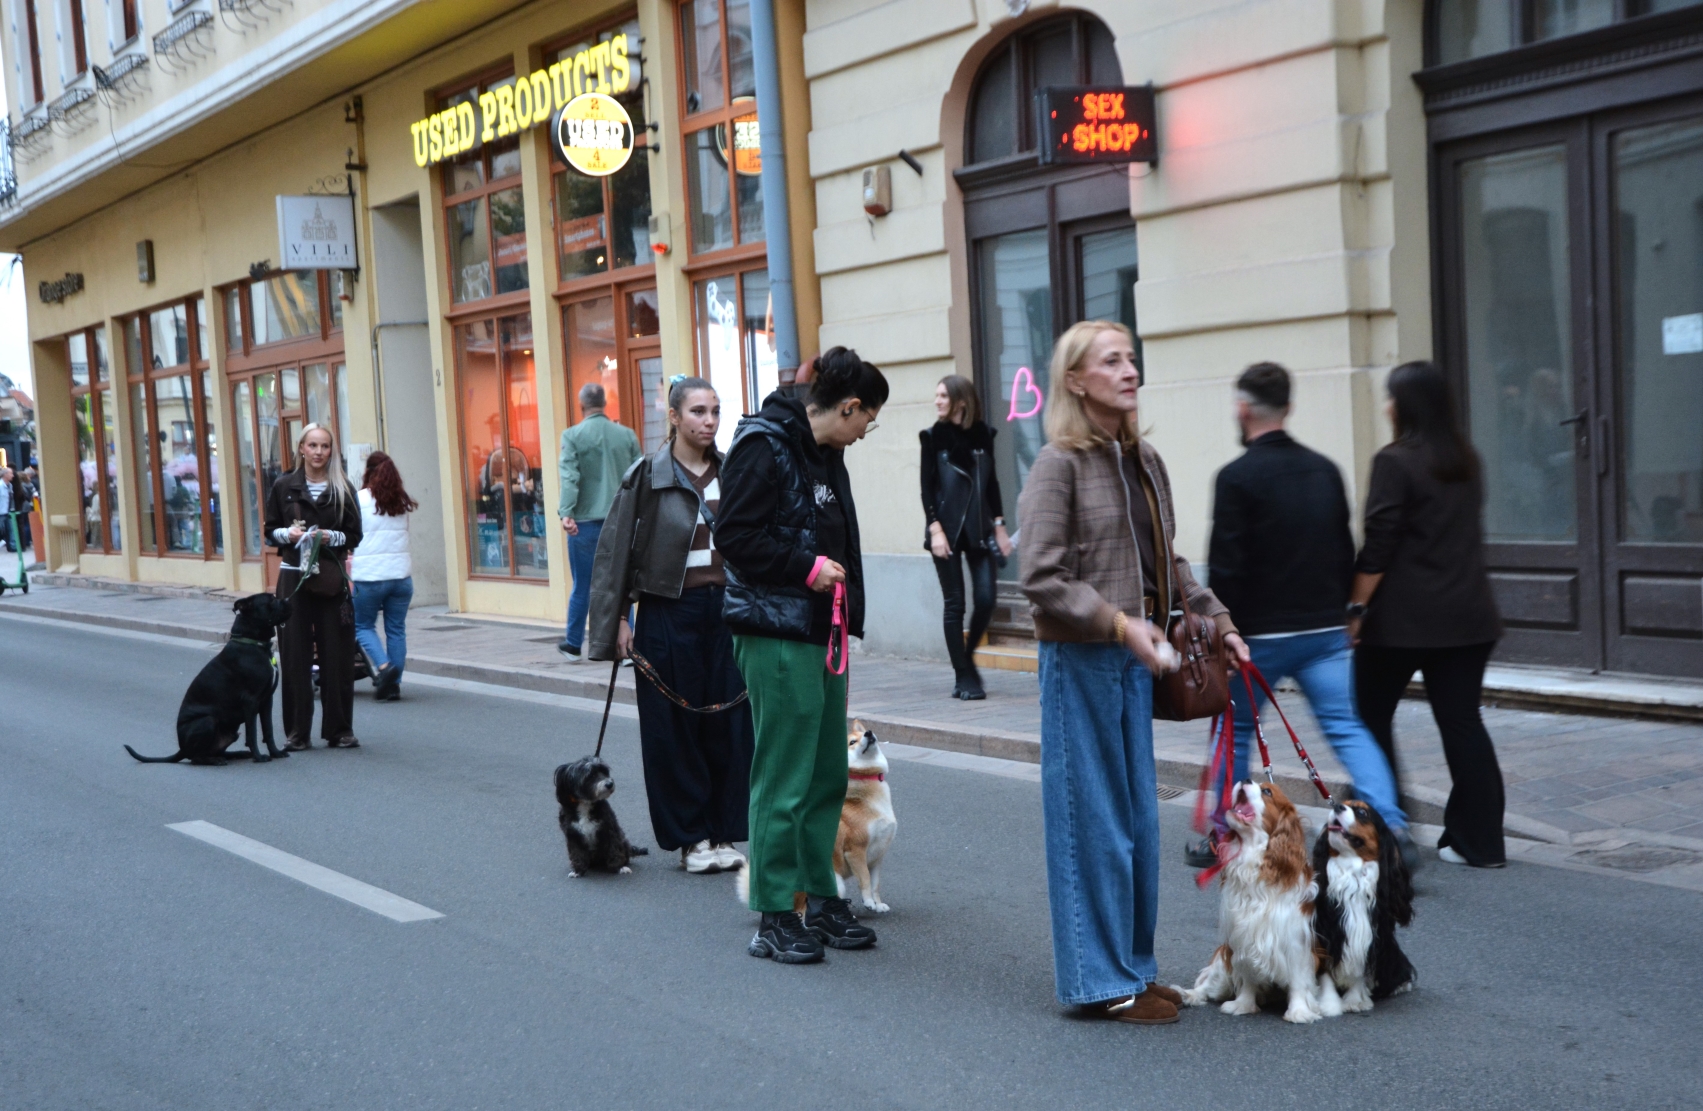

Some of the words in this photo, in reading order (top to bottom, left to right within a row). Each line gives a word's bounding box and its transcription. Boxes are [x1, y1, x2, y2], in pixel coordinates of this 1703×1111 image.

[410, 101, 476, 167] USED
[479, 33, 631, 143] PRODUCTS
[590, 97, 600, 110] 2
[1082, 92, 1125, 120] SEX
[566, 118, 625, 140] USED
[1072, 123, 1140, 152] SHOP
[593, 149, 601, 161] 4
[291, 243, 349, 256] VILI
[435, 368, 442, 387] 2
